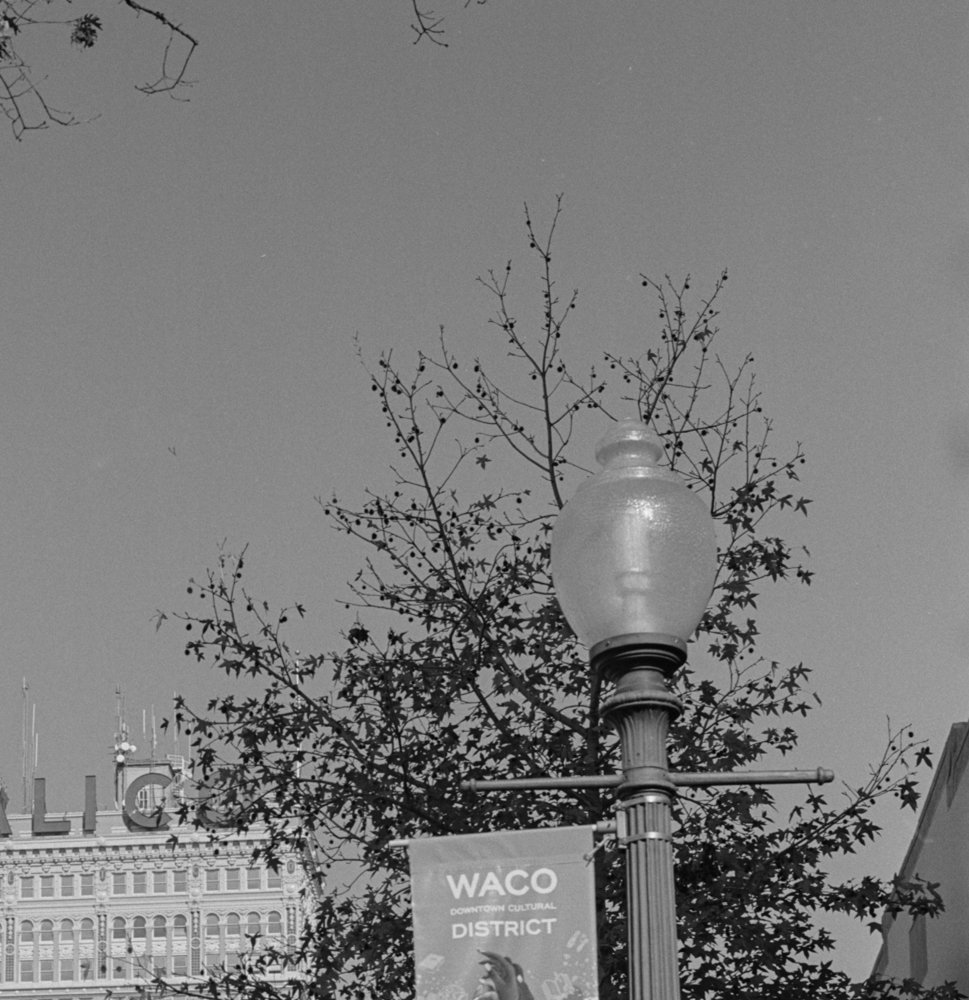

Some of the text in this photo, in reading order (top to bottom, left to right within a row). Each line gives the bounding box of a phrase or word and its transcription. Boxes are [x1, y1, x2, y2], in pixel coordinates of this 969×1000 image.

[446, 867, 558, 899] WACO
[450, 901, 557, 916] DOWNTOWN CULTURAL
[451, 918, 558, 939] DISTRICT
